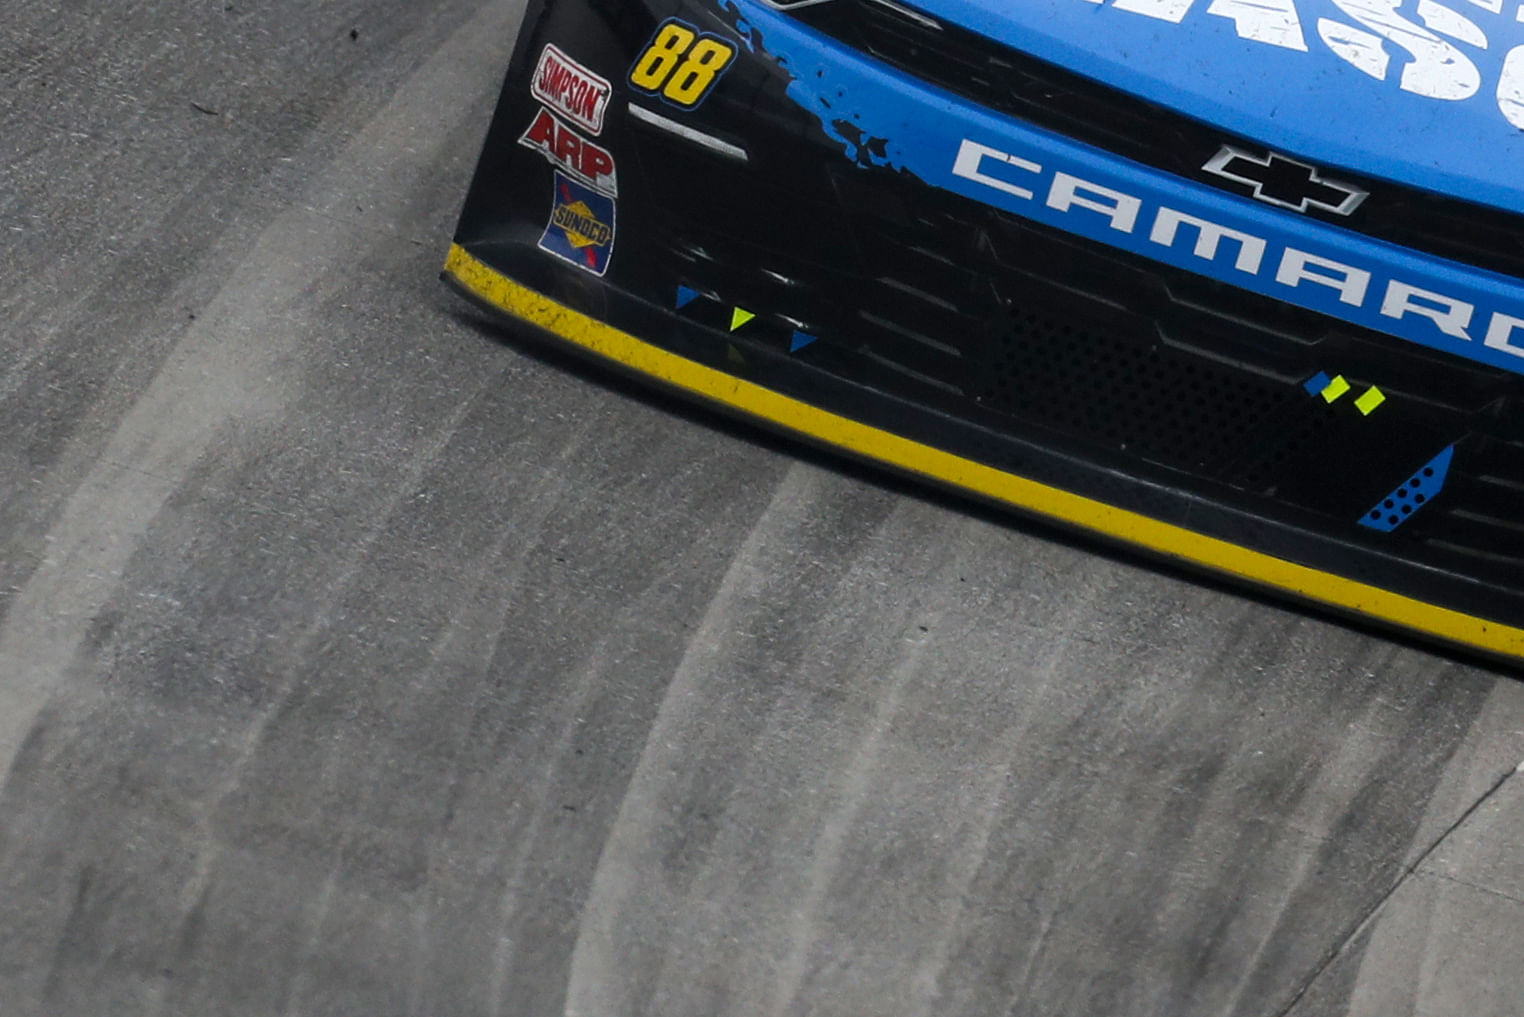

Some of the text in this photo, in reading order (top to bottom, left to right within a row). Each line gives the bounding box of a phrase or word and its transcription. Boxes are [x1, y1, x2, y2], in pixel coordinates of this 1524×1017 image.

[537, 55, 600, 122] SIMPSON
[629, 20, 734, 108] 88
[526, 111, 614, 181] ARP
[555, 205, 611, 242] SUNOCO
